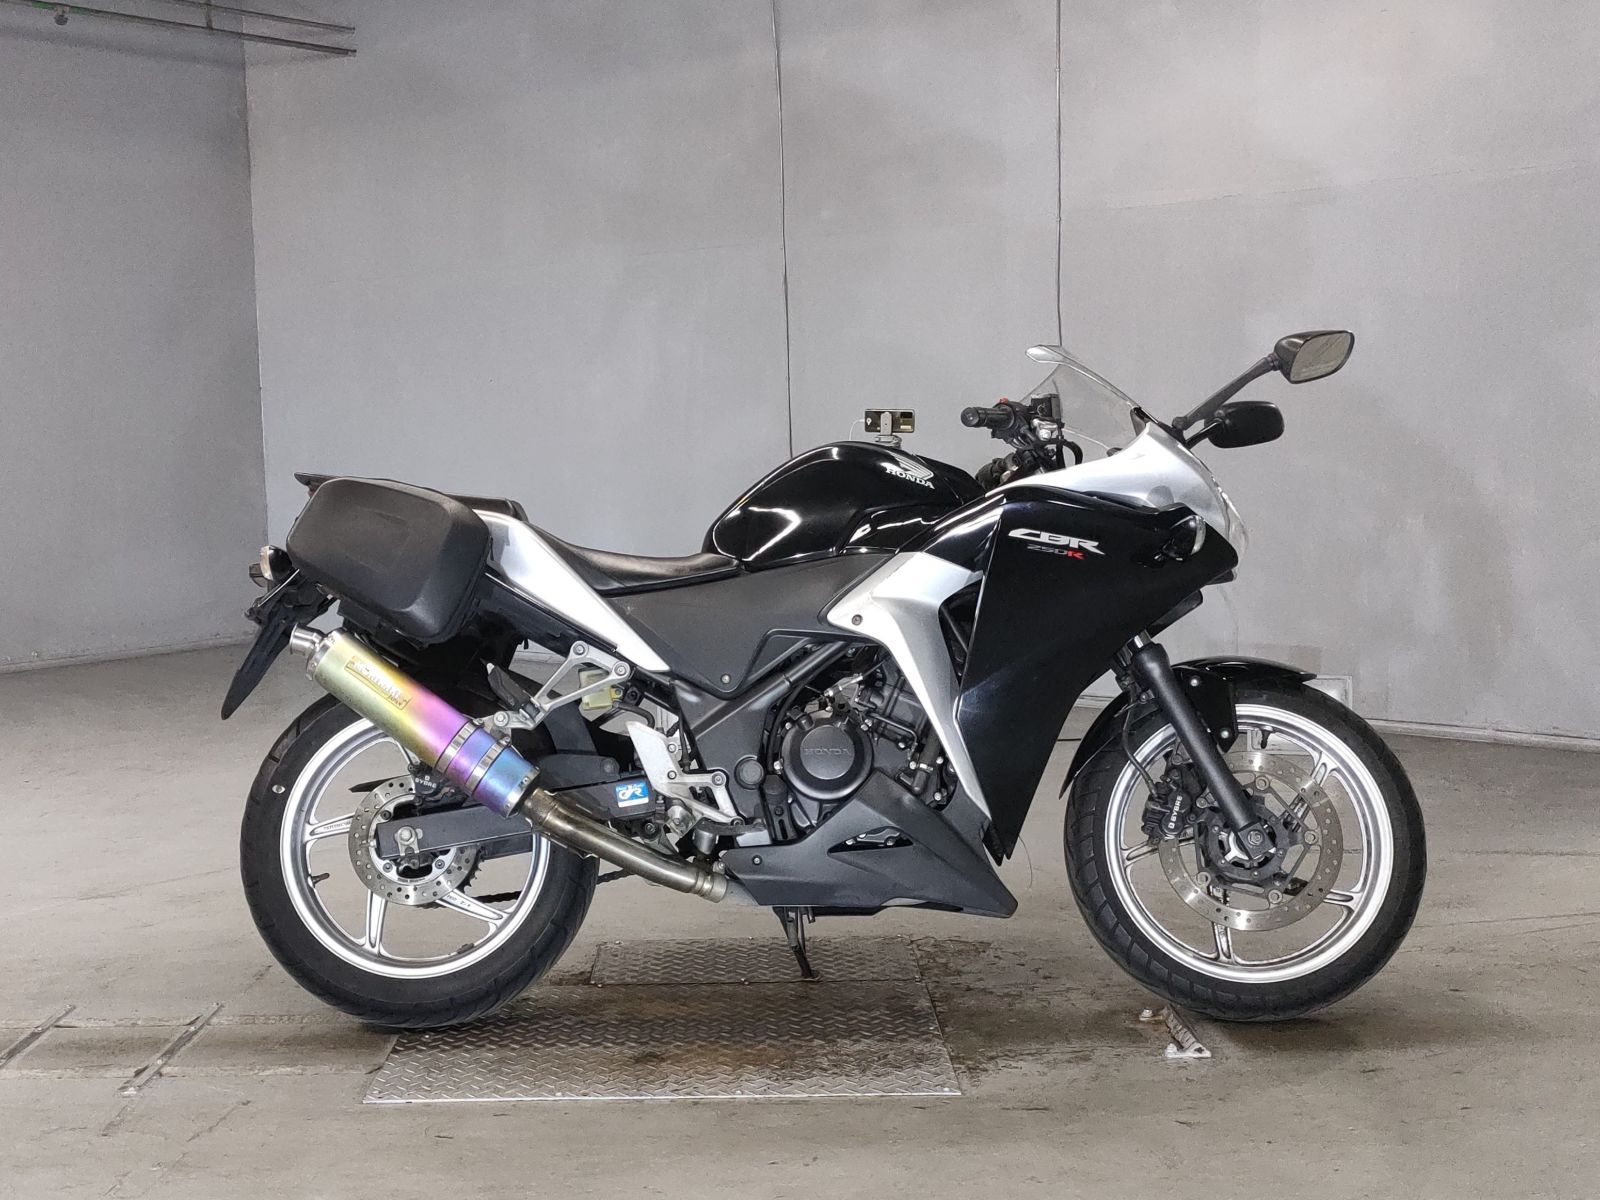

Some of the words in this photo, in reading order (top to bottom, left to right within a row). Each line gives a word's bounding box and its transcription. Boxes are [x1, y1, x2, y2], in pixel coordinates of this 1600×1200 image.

[885, 467, 935, 489] HONDA
[1008, 528, 1105, 555] CBR
[1027, 544, 1084, 560] 250R
